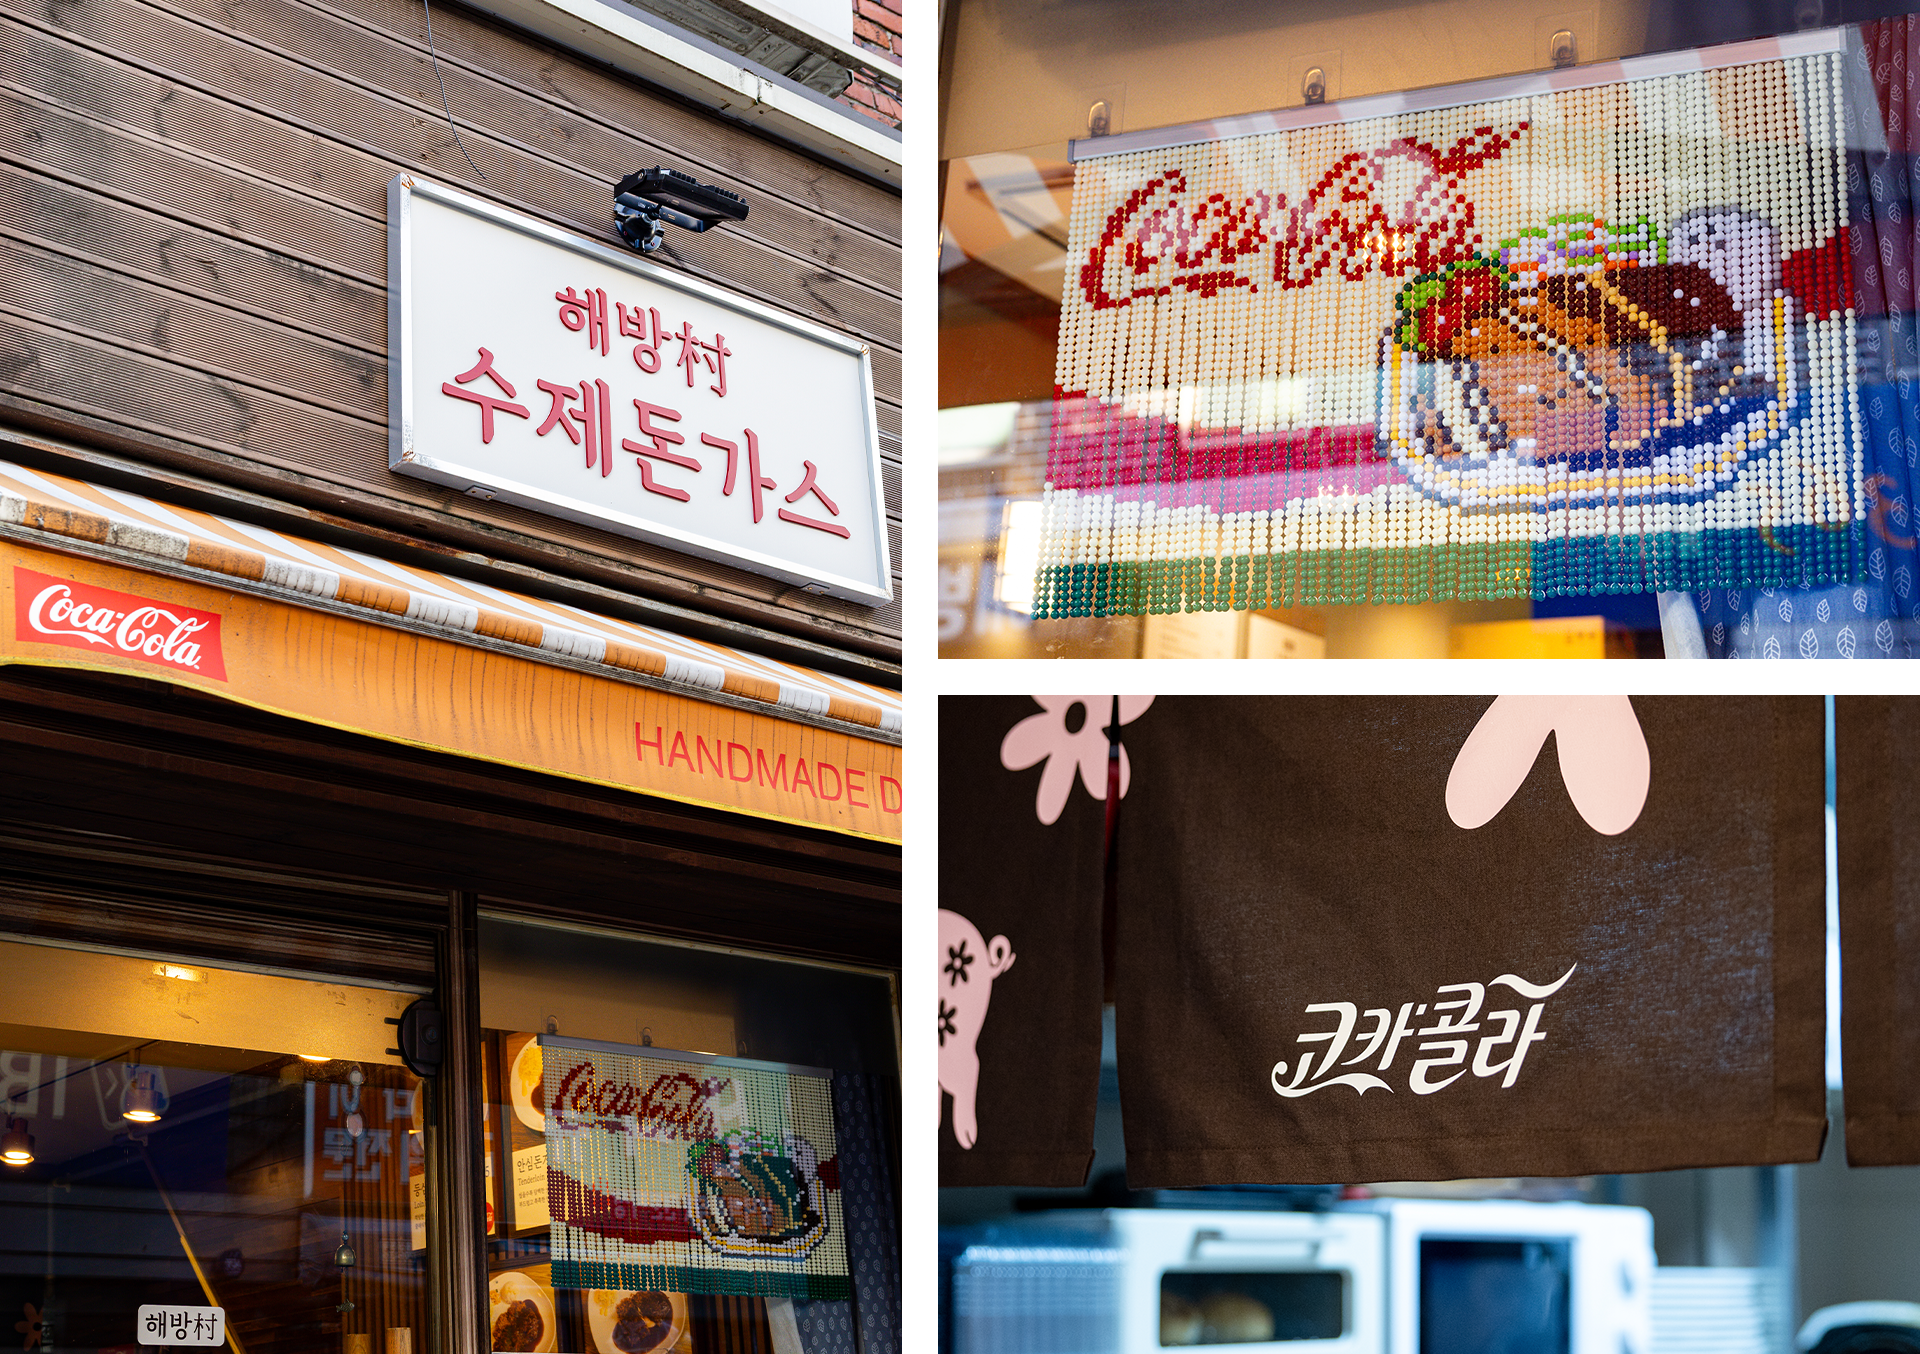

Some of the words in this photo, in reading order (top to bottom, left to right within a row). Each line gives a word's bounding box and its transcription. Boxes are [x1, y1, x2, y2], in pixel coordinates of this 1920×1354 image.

[555, 286, 732, 397] 해방村
[441, 346, 851, 540] 수제돈가스
[28, 584, 210, 670] Coca-Cola
[635, 721, 870, 809] HANDMADE
[1271, 961, 1578, 1098] 코카콜라
[145, 1310, 218, 1341] 해방村
